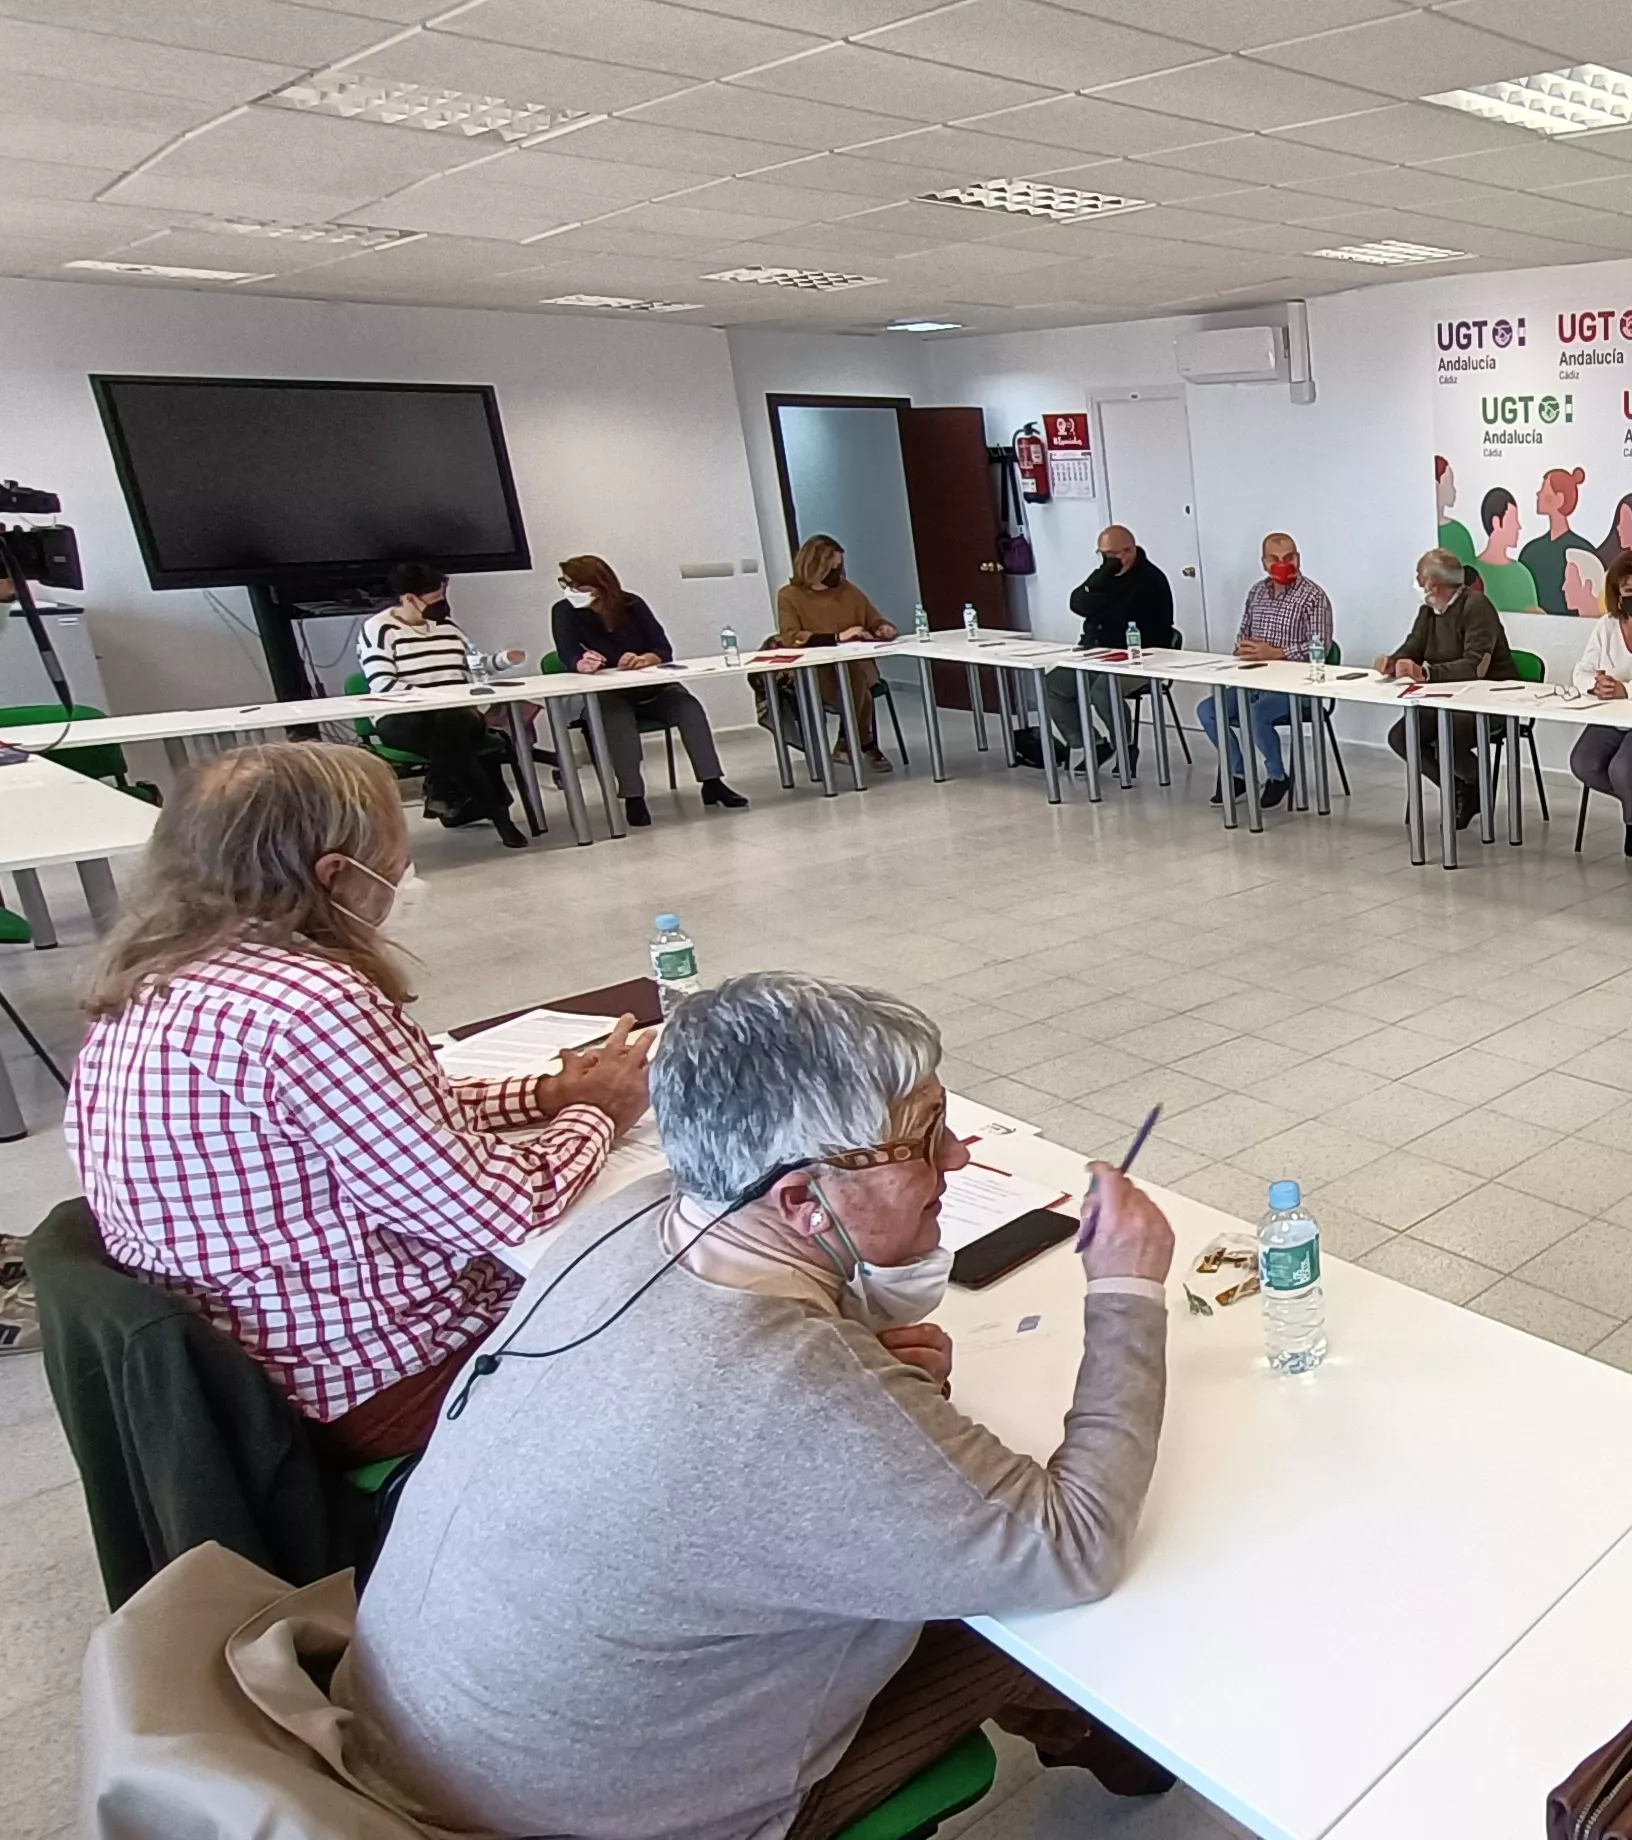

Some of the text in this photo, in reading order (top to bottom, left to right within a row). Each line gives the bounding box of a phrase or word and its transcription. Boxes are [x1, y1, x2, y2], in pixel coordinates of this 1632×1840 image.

[1437, 320, 1487, 350] UGT
[1558, 311, 1615, 343] UGT
[1438, 355, 1496, 371] Andalucía
[1559, 348, 1624, 366] Andalucía
[1439, 375, 1457, 384] Cádiz
[1559, 370, 1579, 380] Cádiz
[1482, 395, 1534, 424] UGT
[1483, 429, 1543, 444] Andalucía
[1483, 449, 1502, 457] Cádiz
